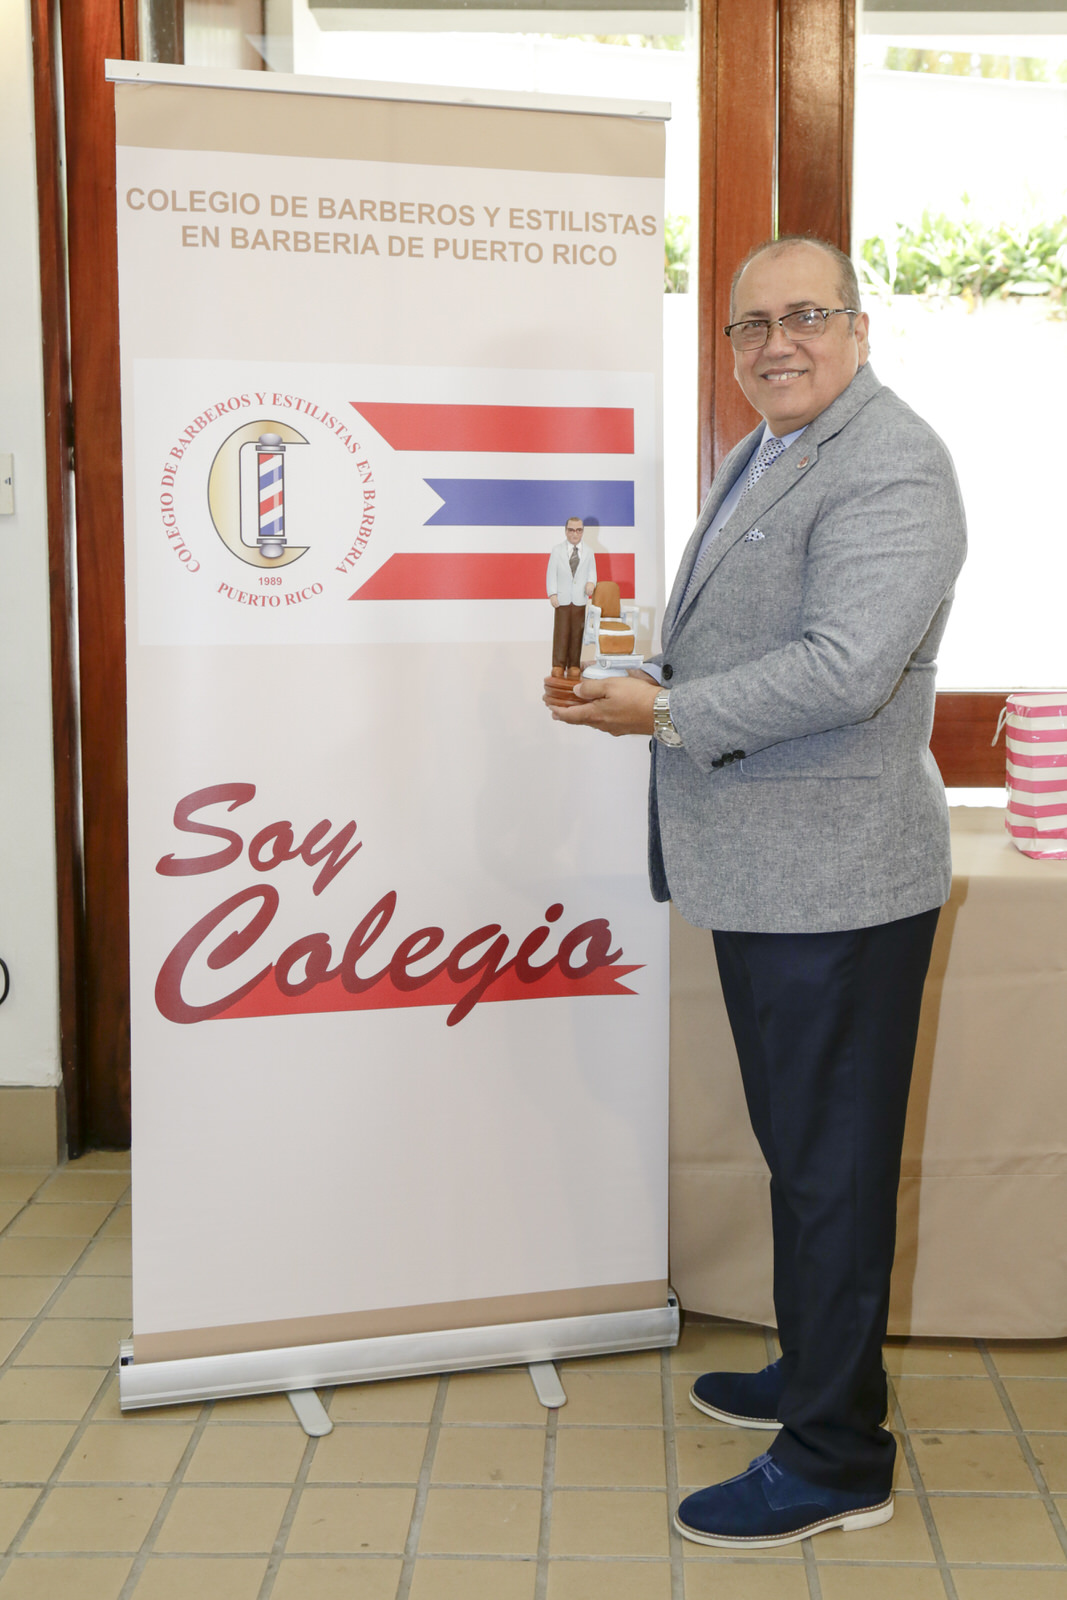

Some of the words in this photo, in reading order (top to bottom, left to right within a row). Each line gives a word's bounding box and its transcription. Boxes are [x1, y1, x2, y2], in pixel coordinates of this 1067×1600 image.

[126, 187, 261, 215] COLEGIO
[270, 194, 308, 218] DE
[318, 197, 475, 226] BARBEROS
[483, 206, 501, 227] Y
[509, 207, 657, 236] ESTILISTAS
[181, 225, 220, 248] EN
[231, 227, 380, 256] BARBERIA
[388, 235, 424, 258] DE
[434, 237, 544, 264] PUERTO
[553, 243, 617, 267] RICO
[255, 392, 267, 406] Y
[272, 393, 361, 454] ESTILISTAS
[169, 393, 251, 461] BARBEROS
[161, 462, 178, 488] DE
[356, 459, 374, 484] EN
[160, 492, 201, 573] COLEGIO
[335, 489, 376, 576] BARBERIA
[217, 582, 281, 607] PUERTO
[285, 582, 323, 606] RICO
[258, 577, 283, 586] 1989
[155, 782, 363, 896] Soy
[154, 883, 623, 1027] Colegio
